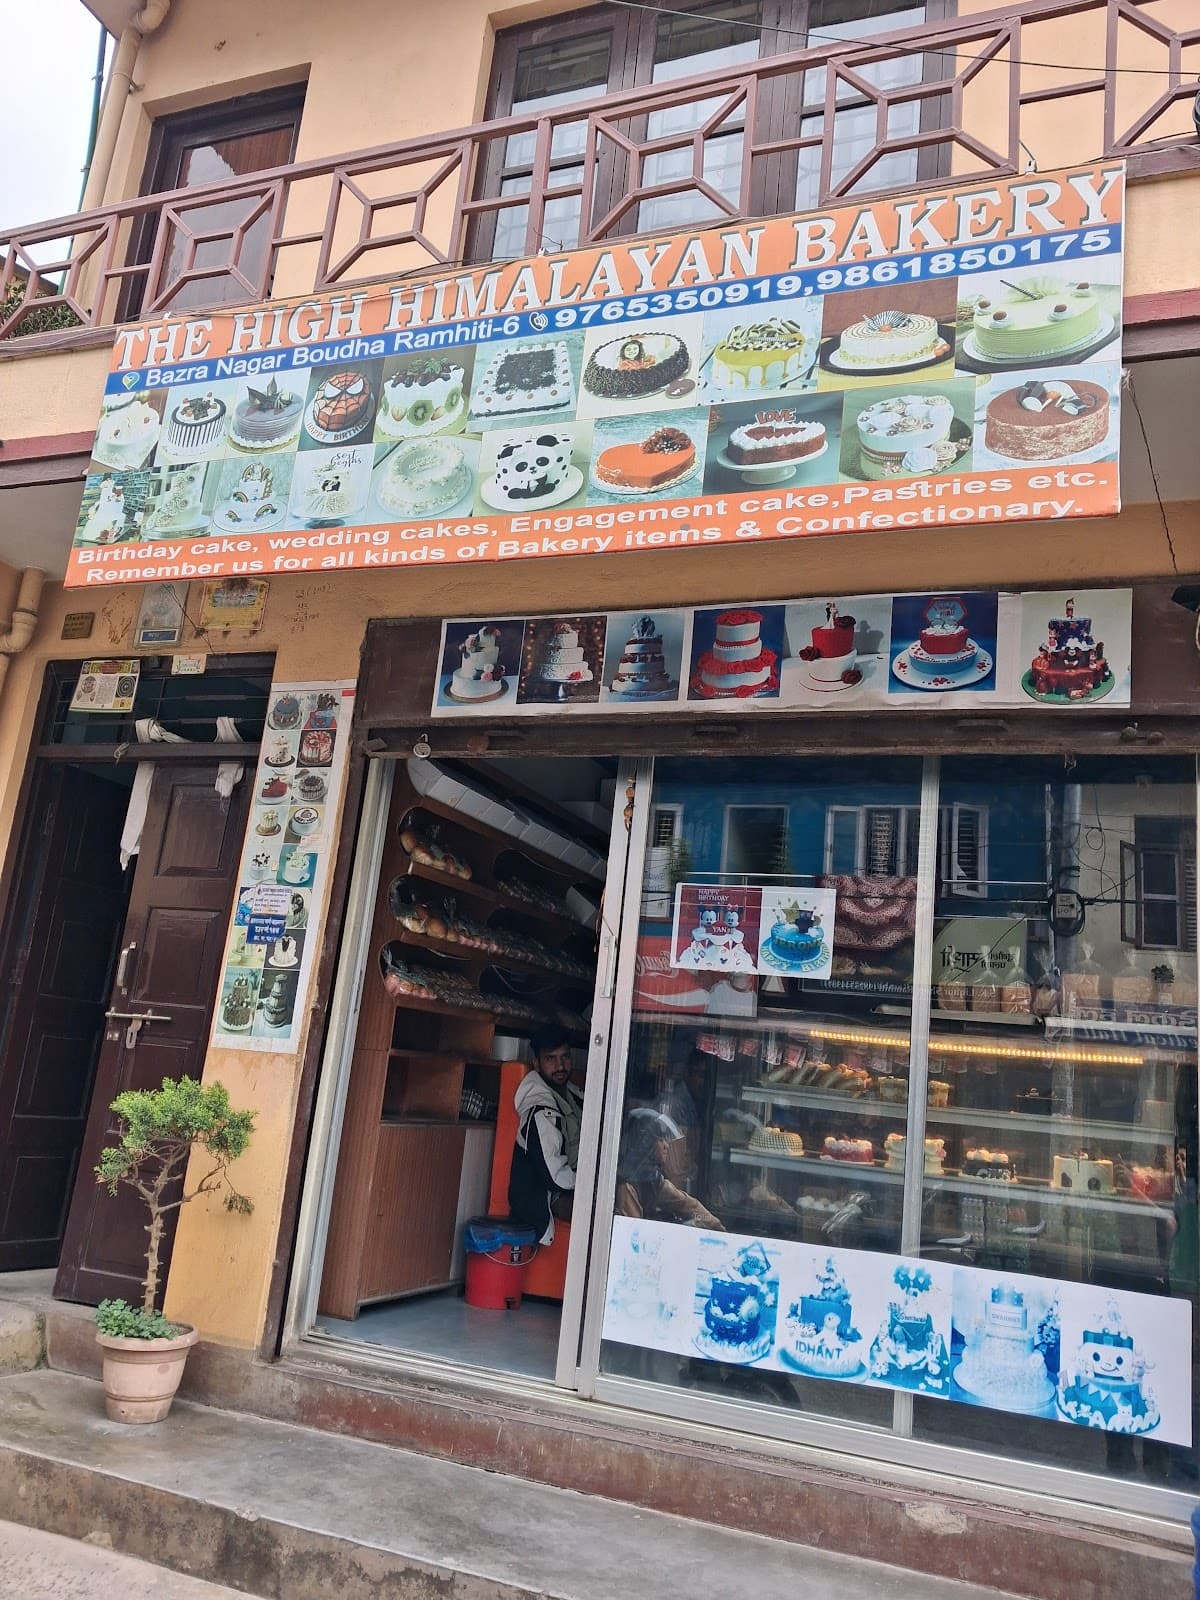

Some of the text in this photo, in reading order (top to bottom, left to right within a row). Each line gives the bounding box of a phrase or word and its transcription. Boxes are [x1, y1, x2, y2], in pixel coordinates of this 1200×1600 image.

[115, 172, 1125, 370] THE HIGH HIMALAYAN BAKERY
[145, 228, 1112, 388] Bazra Nagar Boudha Ramhiti-6 9765350919,9861850175
[755, 408, 797, 424] LOVE
[77, 544, 182, 568] Birthday
[190, 538, 259, 559] cake,
[269, 527, 390, 555] wedding
[400, 520, 498, 543] cakes,
[510, 497, 728, 535] Engagement
[1034, 470, 1109, 490] etc.
[86, 498, 1086, 583] Remember us for all kinds of Bakery items & Confectionary.
